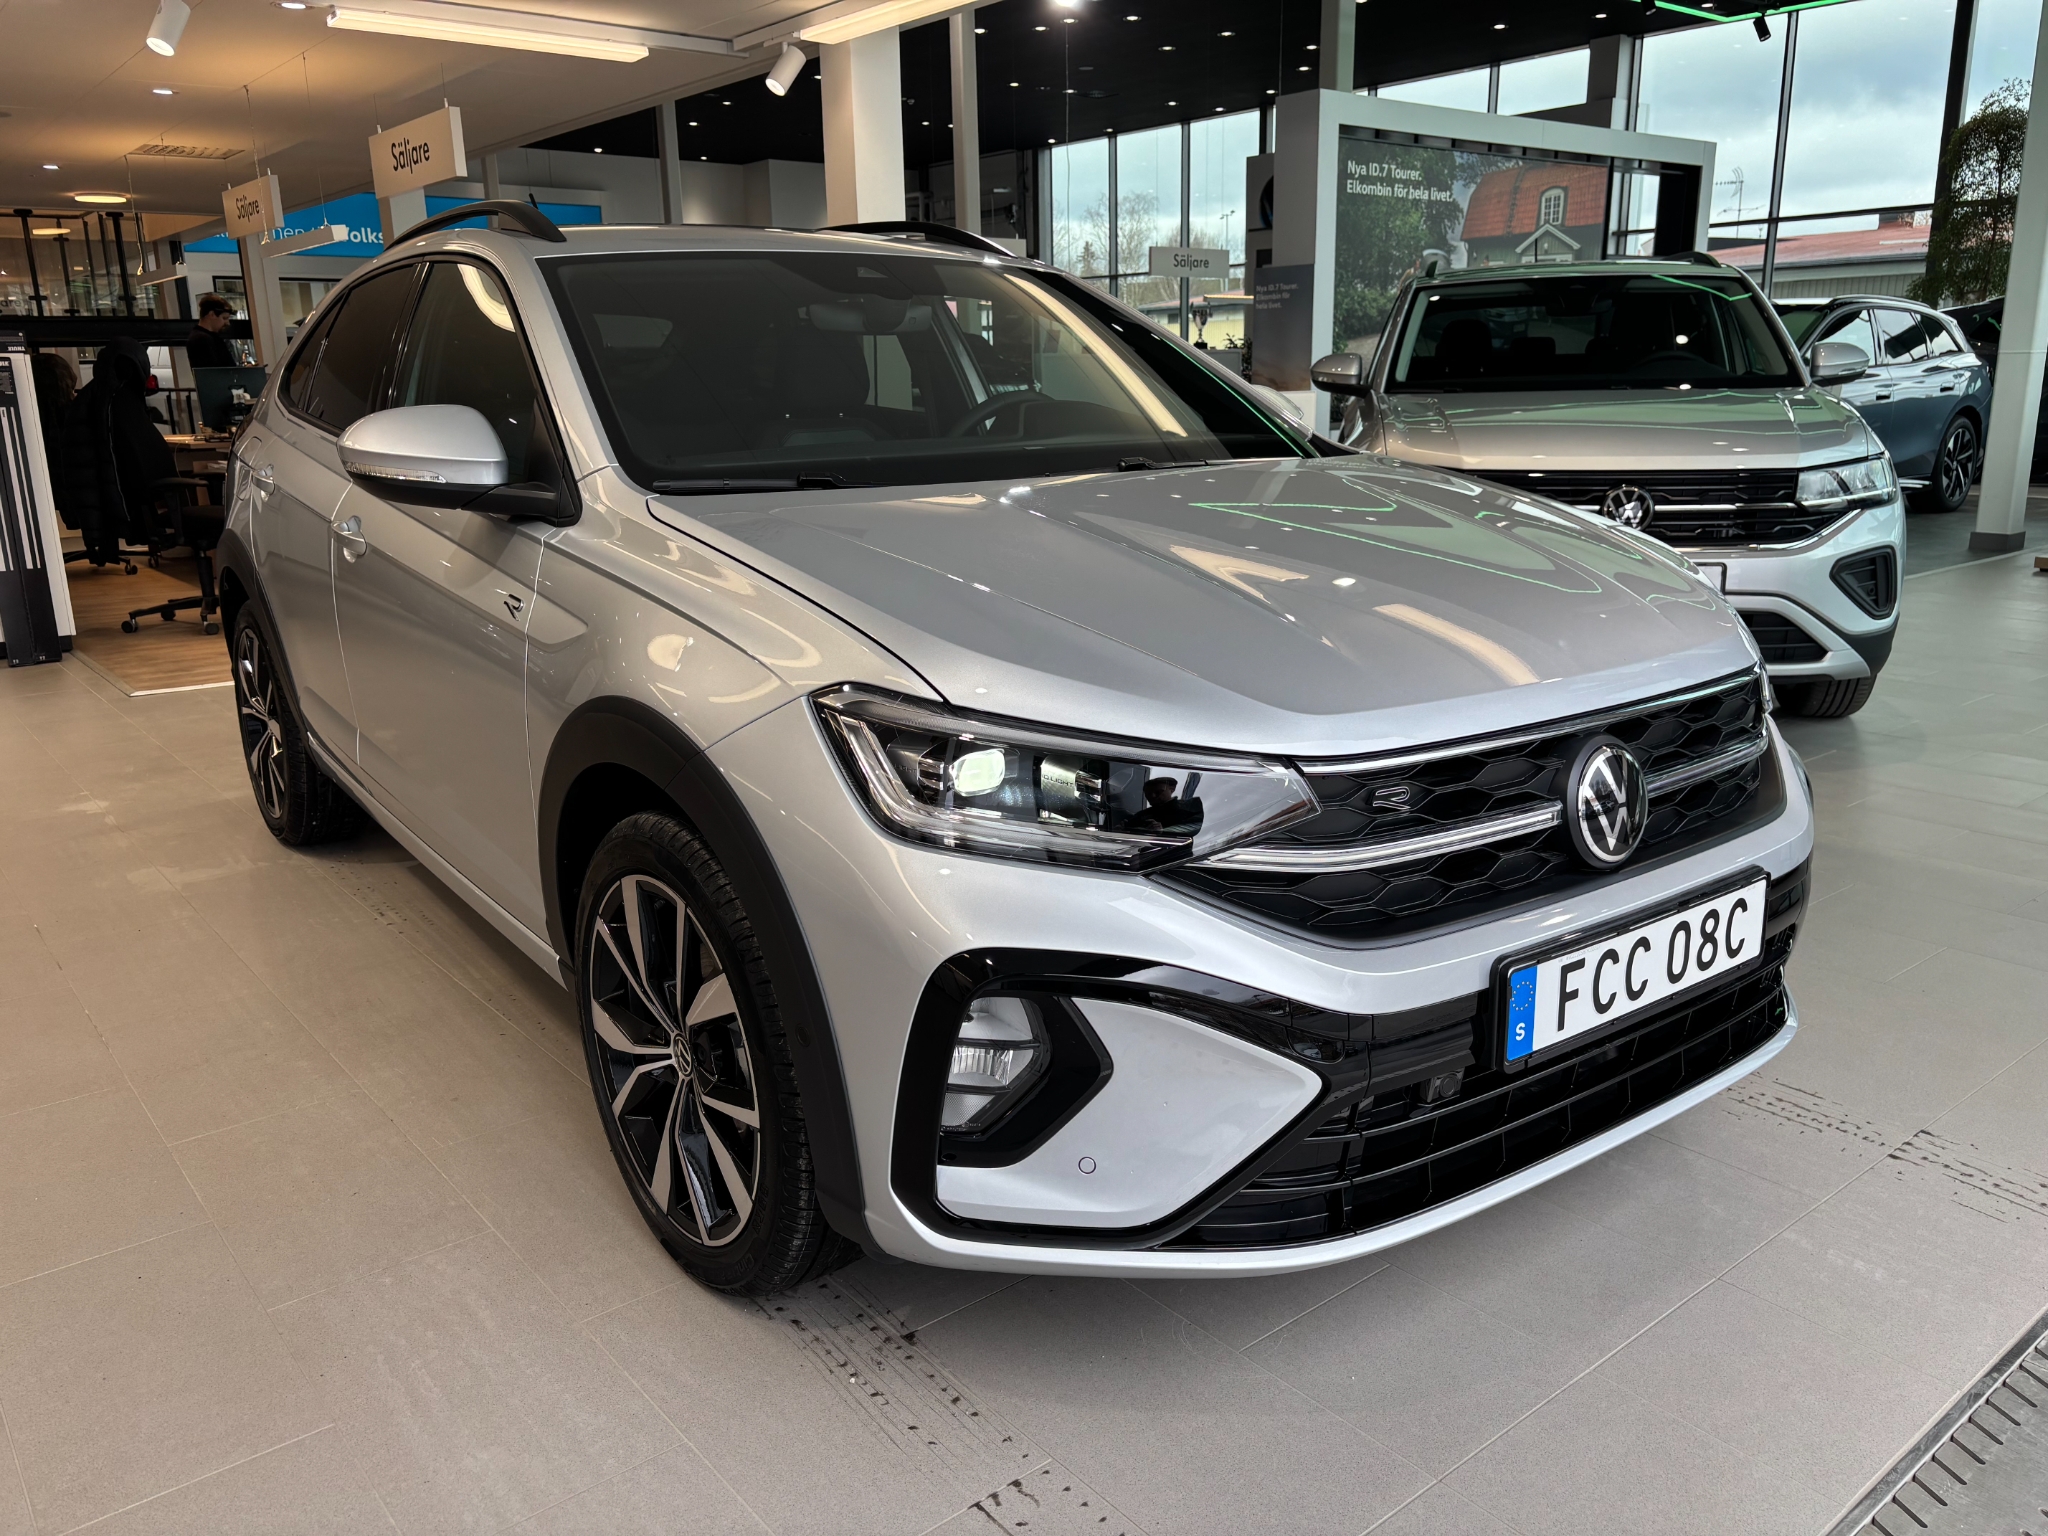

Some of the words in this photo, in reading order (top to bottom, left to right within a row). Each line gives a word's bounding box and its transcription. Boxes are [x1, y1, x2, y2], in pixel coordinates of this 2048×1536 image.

[391, 137, 430, 174] Säljare
[1347, 160, 1367, 178] Nya
[1369, 162, 1389, 177] ID.7
[1390, 165, 1422, 181] Tourer.
[1346, 179, 1392, 197] Elkombin
[1393, 183, 1408, 198] för
[1409, 185, 1429, 200] hela
[1430, 187, 1453, 202] livet.
[235, 194, 260, 223] Säljare
[347, 226, 383, 244] olks
[1173, 253, 1210, 271] Säljare
[1557, 936, 1651, 1032] FCC
[1666, 897, 1748, 985] 08C
[1515, 1022, 1526, 1041] S
